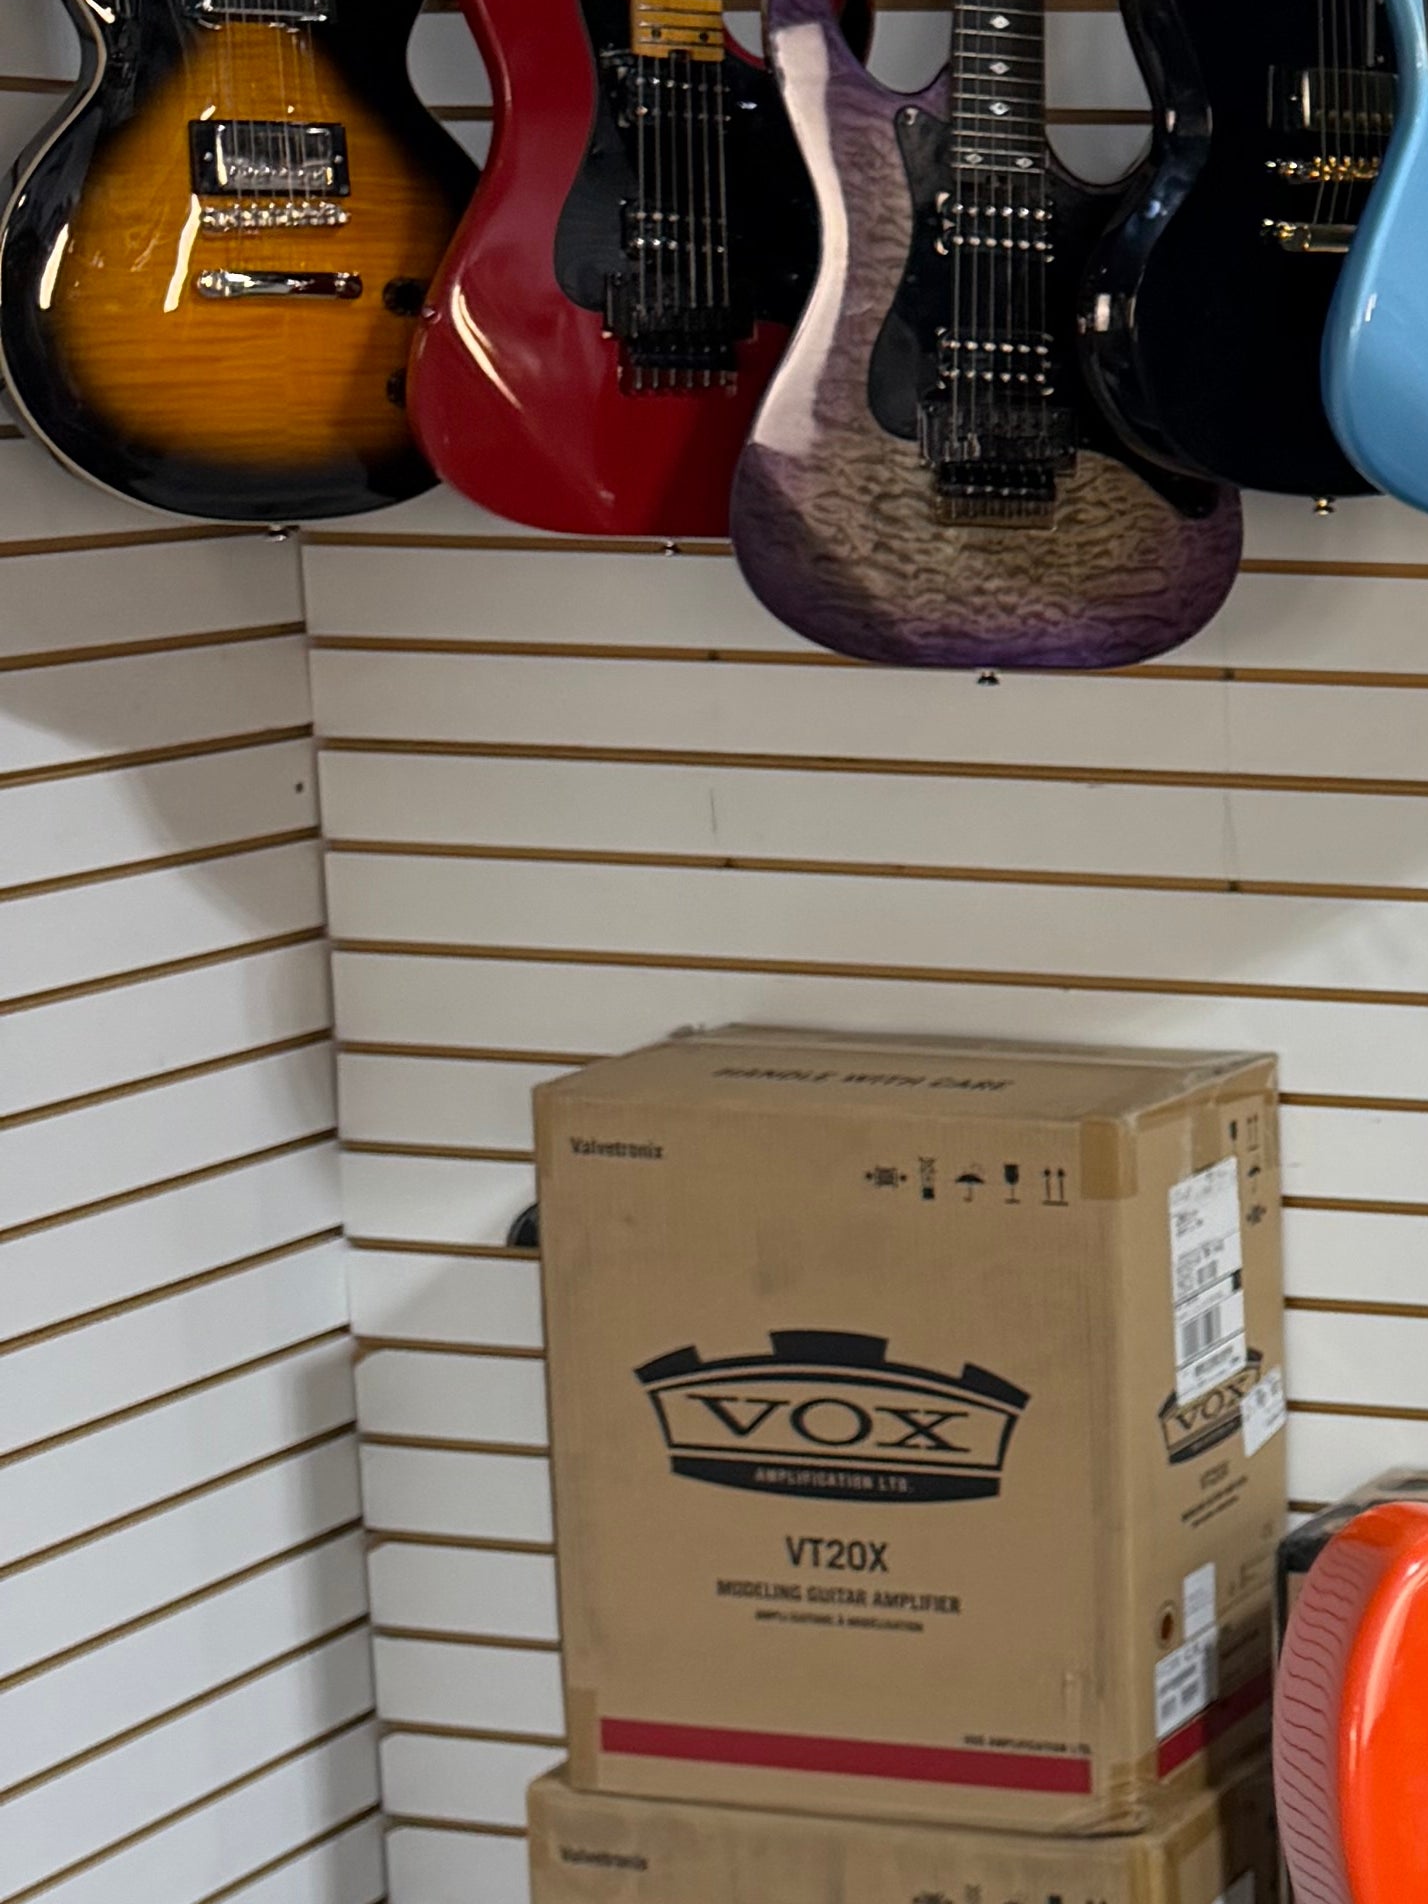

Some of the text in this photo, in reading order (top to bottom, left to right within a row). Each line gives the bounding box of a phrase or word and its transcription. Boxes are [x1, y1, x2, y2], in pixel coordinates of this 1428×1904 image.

[712, 1065, 1016, 1092] HANDLE WITH CARE
[569, 1136, 664, 1161] Valvetronix
[685, 1393, 971, 1453] VOX
[755, 1466, 873, 1492] AMPLIFICATION
[785, 1535, 890, 1573] VT20X
[716, 1578, 961, 1615] MODELING GUITAR AMPLIFIER
